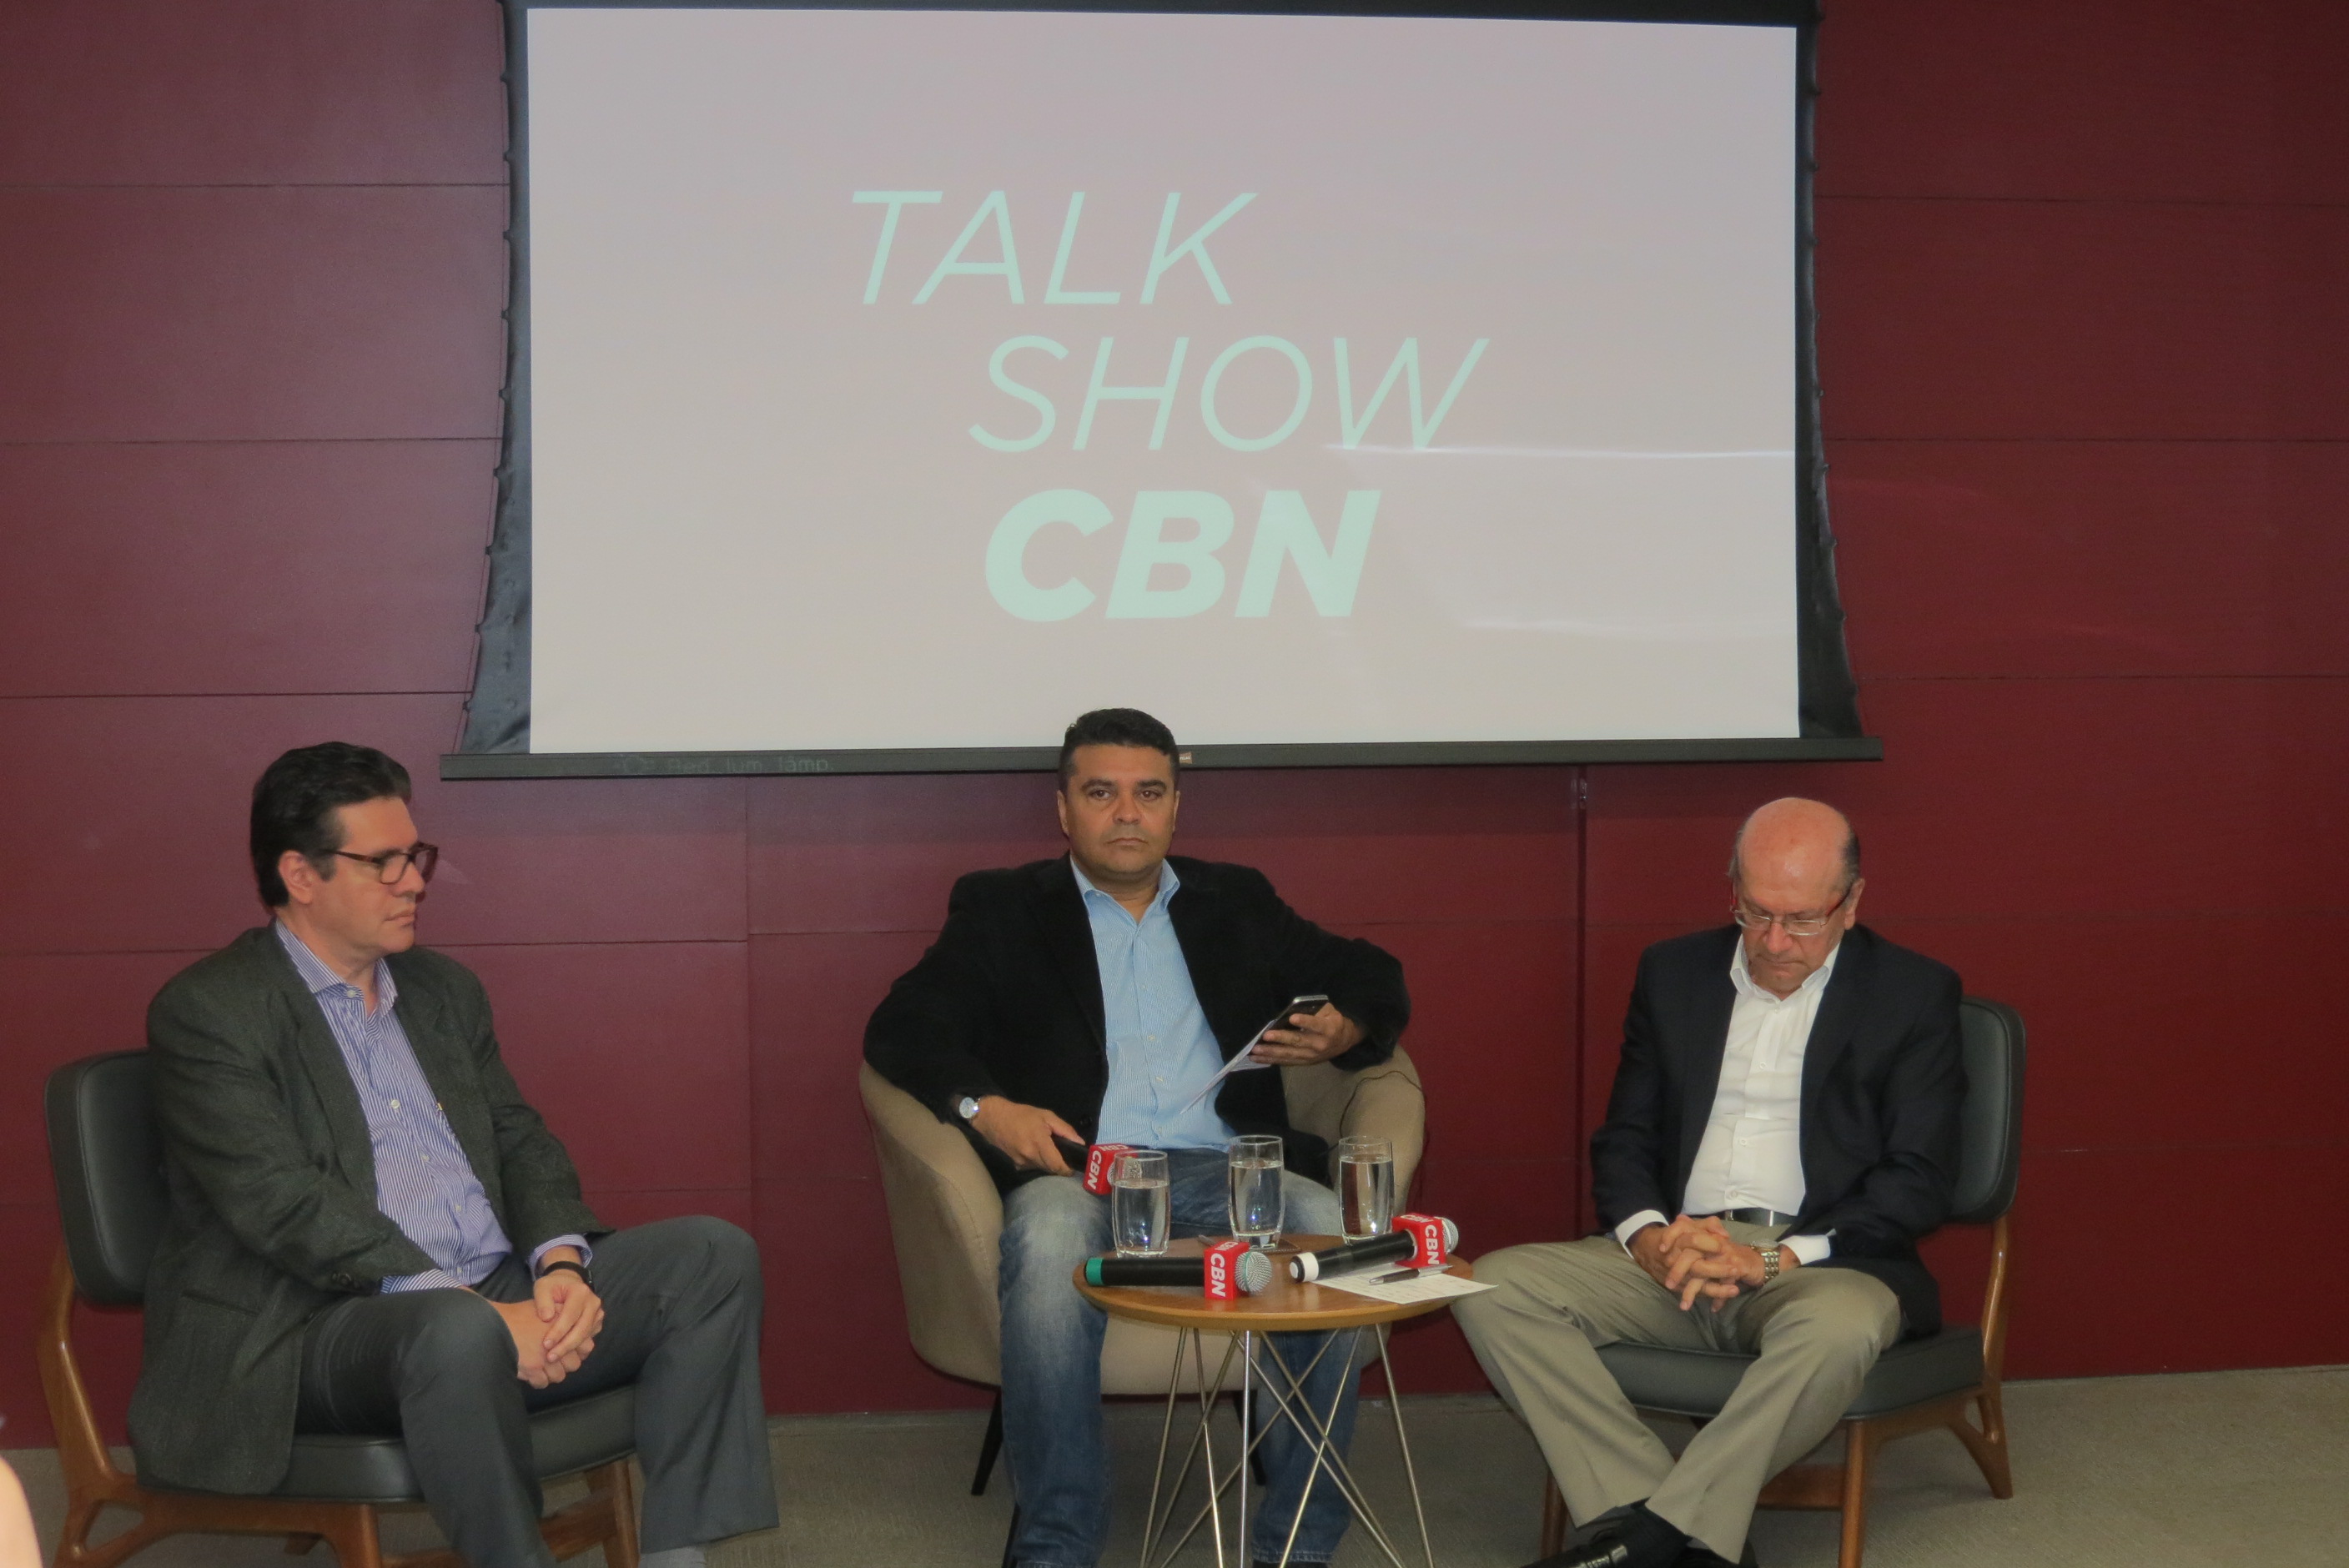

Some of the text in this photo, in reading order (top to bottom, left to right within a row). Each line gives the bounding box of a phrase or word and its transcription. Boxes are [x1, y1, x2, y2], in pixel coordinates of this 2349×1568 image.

[852, 190, 1259, 304] TALK
[968, 335, 1491, 452] SHOW
[985, 488, 1382, 622] CBN
[1087, 1150, 1102, 1190] CBN
[1210, 1253, 1226, 1297] CBN
[1425, 1224, 1440, 1264] CBN
